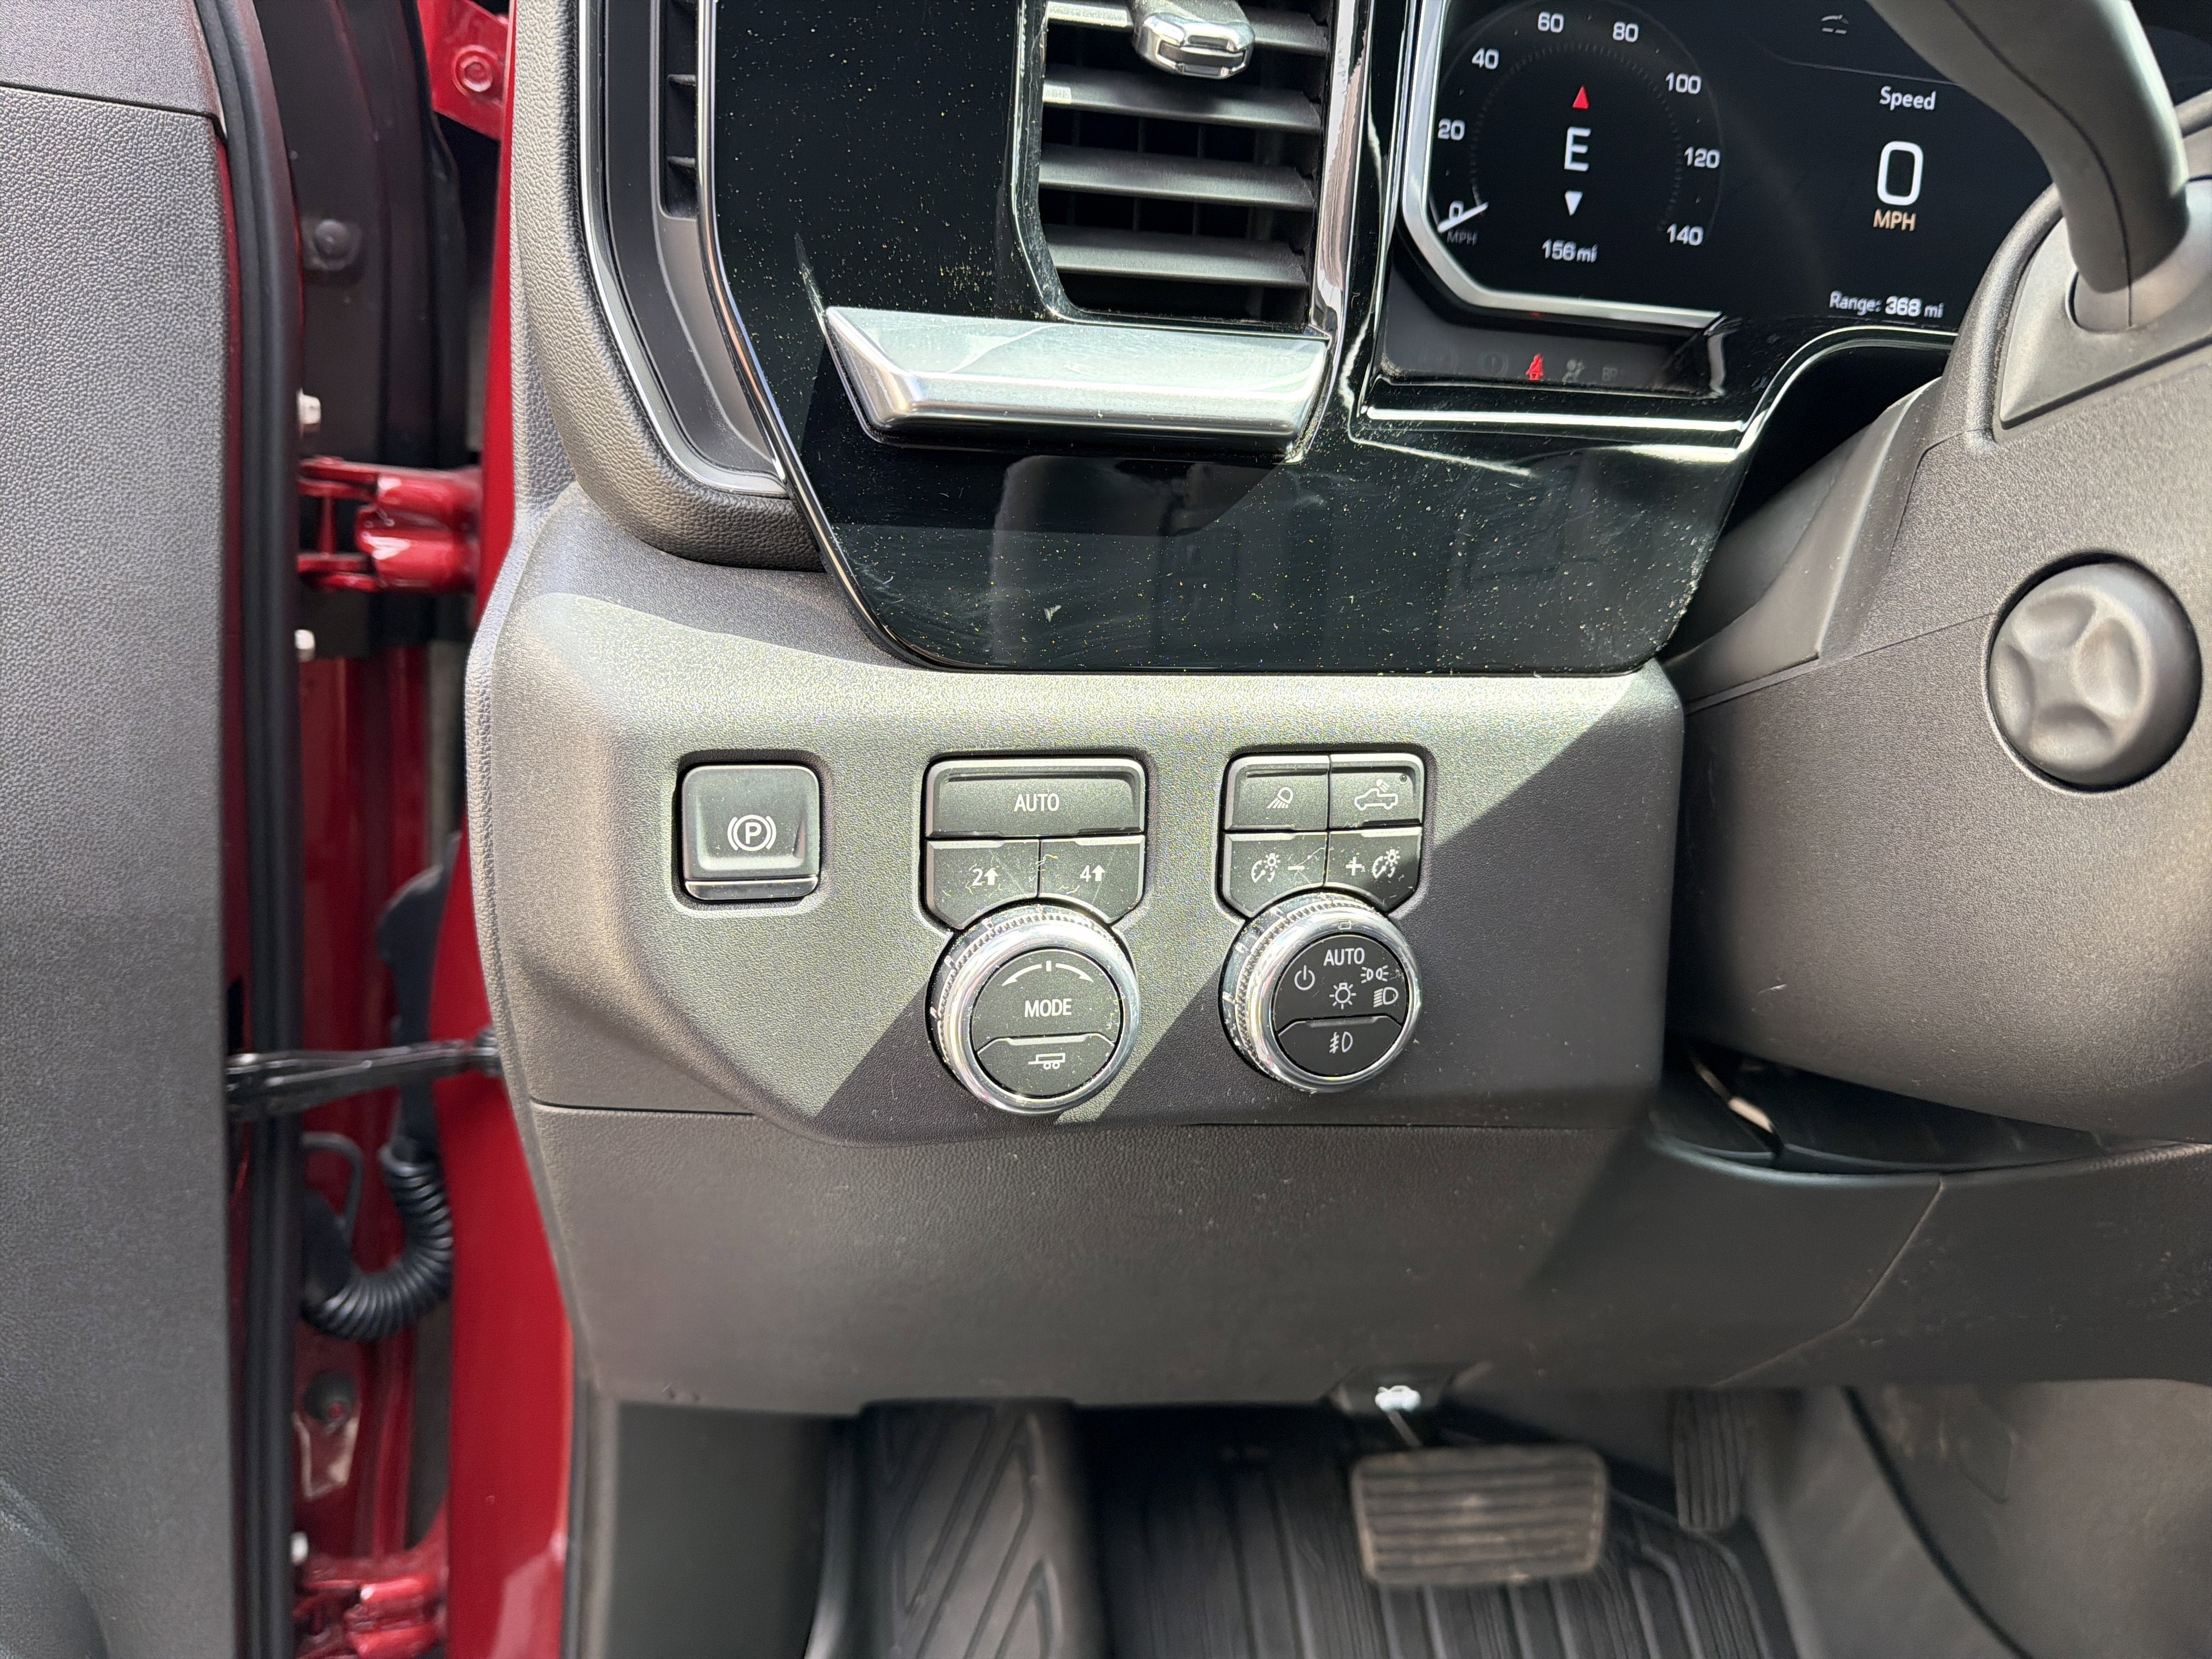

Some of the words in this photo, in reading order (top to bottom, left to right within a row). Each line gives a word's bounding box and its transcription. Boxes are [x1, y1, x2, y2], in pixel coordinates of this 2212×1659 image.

[1537, 12, 1564, 33] 60
[1612, 22, 1639, 42] 80
[1471, 48, 1499, 70] 40
[1665, 72, 1701, 94] 100
[1880, 86, 1936, 111] Speed
[1437, 119, 1465, 140] 20
[1564, 126, 1590, 172] E
[1684, 146, 1720, 168] 120
[1876, 140, 1923, 206] 0
[1873, 210, 1916, 232] MPH
[1447, 229, 1478, 246] MPH
[1666, 224, 1703, 246] 140
[1542, 238, 1577, 261] 156
[1576, 244, 1598, 263] mi
[1829, 290, 1882, 315] Range:
[1885, 296, 1922, 317] 368
[1924, 302, 1944, 318] mi
[1014, 793, 1059, 812] AUTO
[1323, 947, 1364, 966] AUTO
[1024, 998, 1071, 1018] MODE
